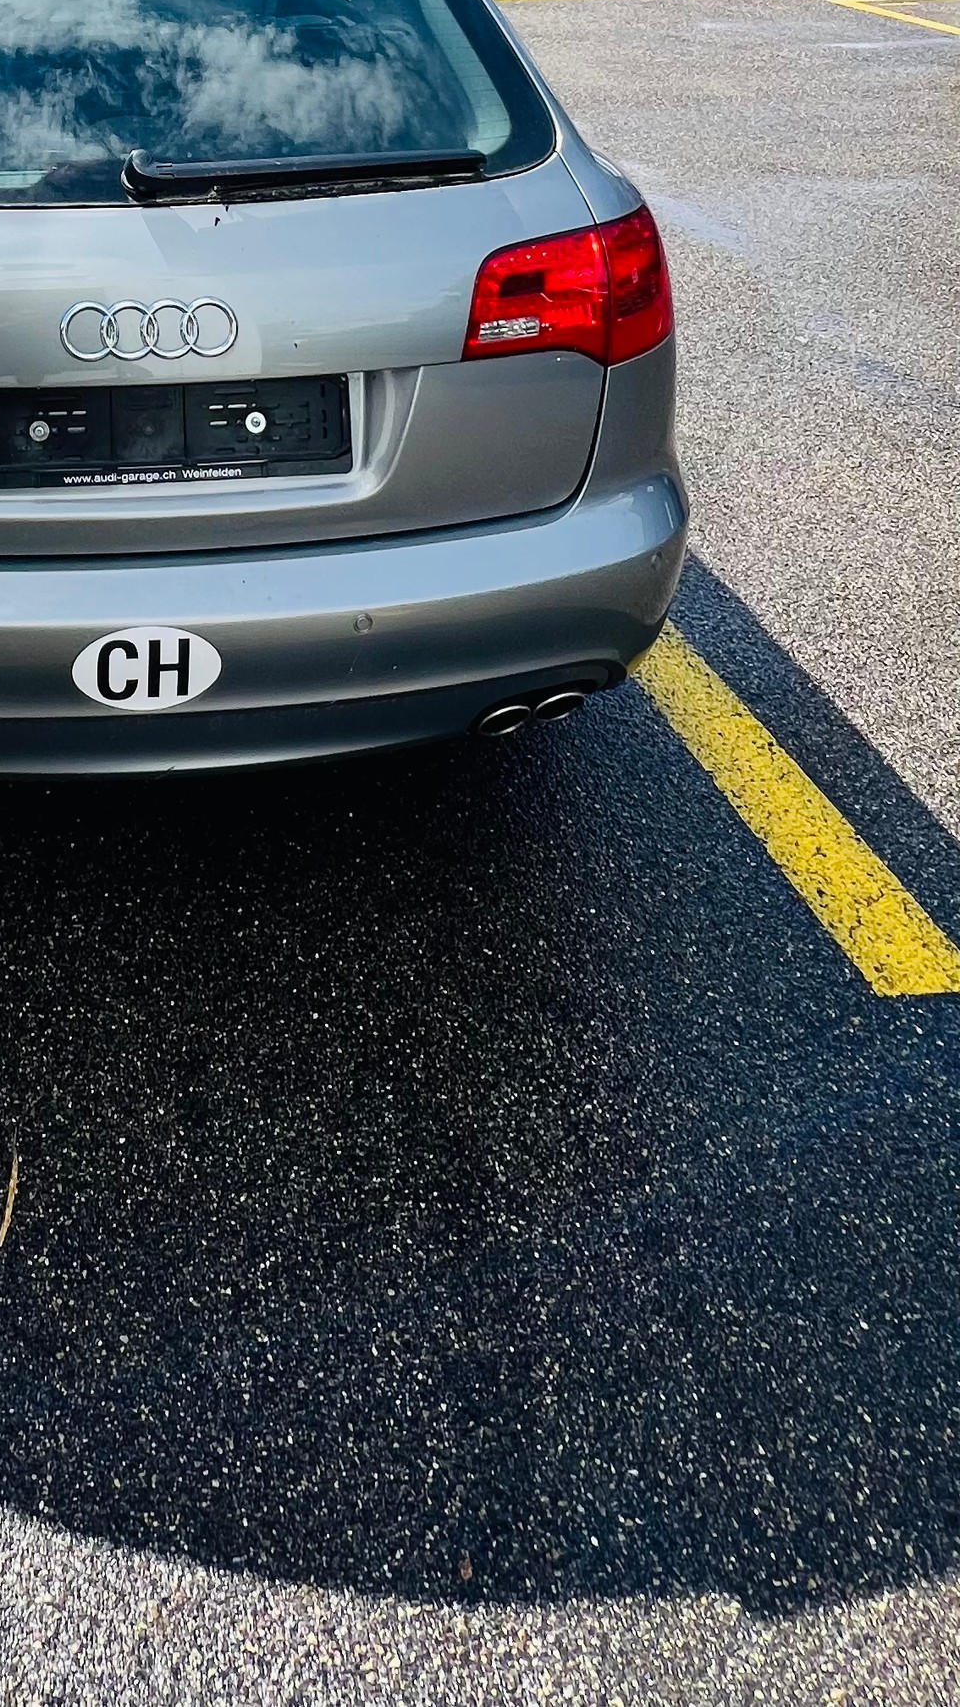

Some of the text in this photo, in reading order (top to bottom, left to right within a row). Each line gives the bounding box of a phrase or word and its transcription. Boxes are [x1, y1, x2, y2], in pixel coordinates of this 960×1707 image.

[63, 467, 242, 484] www.audi-garage.ch Weinfelden
[97, 638, 190, 701] CH
